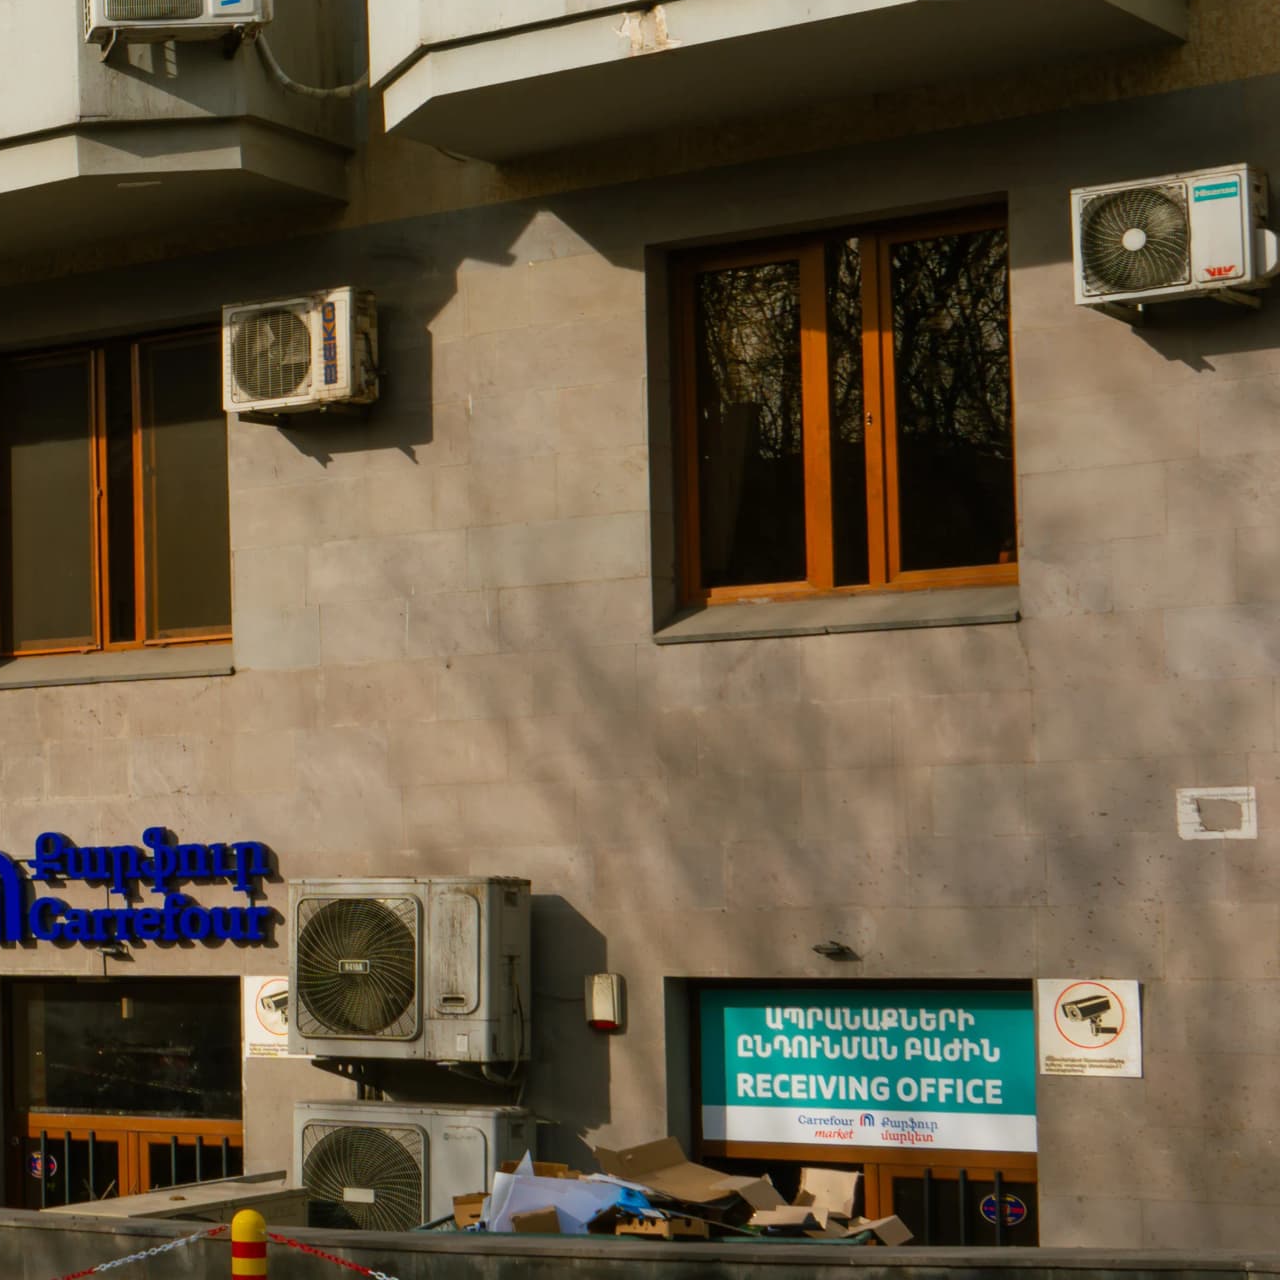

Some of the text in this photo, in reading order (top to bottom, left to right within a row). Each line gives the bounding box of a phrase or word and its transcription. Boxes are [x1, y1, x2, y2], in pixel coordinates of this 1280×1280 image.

[322, 302, 338, 386] BEKO
[28, 826, 271, 894] Քարֆուր
[29, 892, 271, 941] Carrefour
[765, 1007, 976, 1032] ԱՊՐԱՆԱՔՆԵՐԻ
[737, 1034, 1001, 1062] ԸՆԴՈՒՆՄԱՆ ԲԱԺԻՆ
[737, 1073, 1003, 1105] RECEIVING OFFICE
[798, 1114, 854, 1127] Carrefour
[881, 1116, 938, 1133] Քարֆուր
[814, 1129, 854, 1140] market
[881, 1129, 934, 1145] մարկետ
